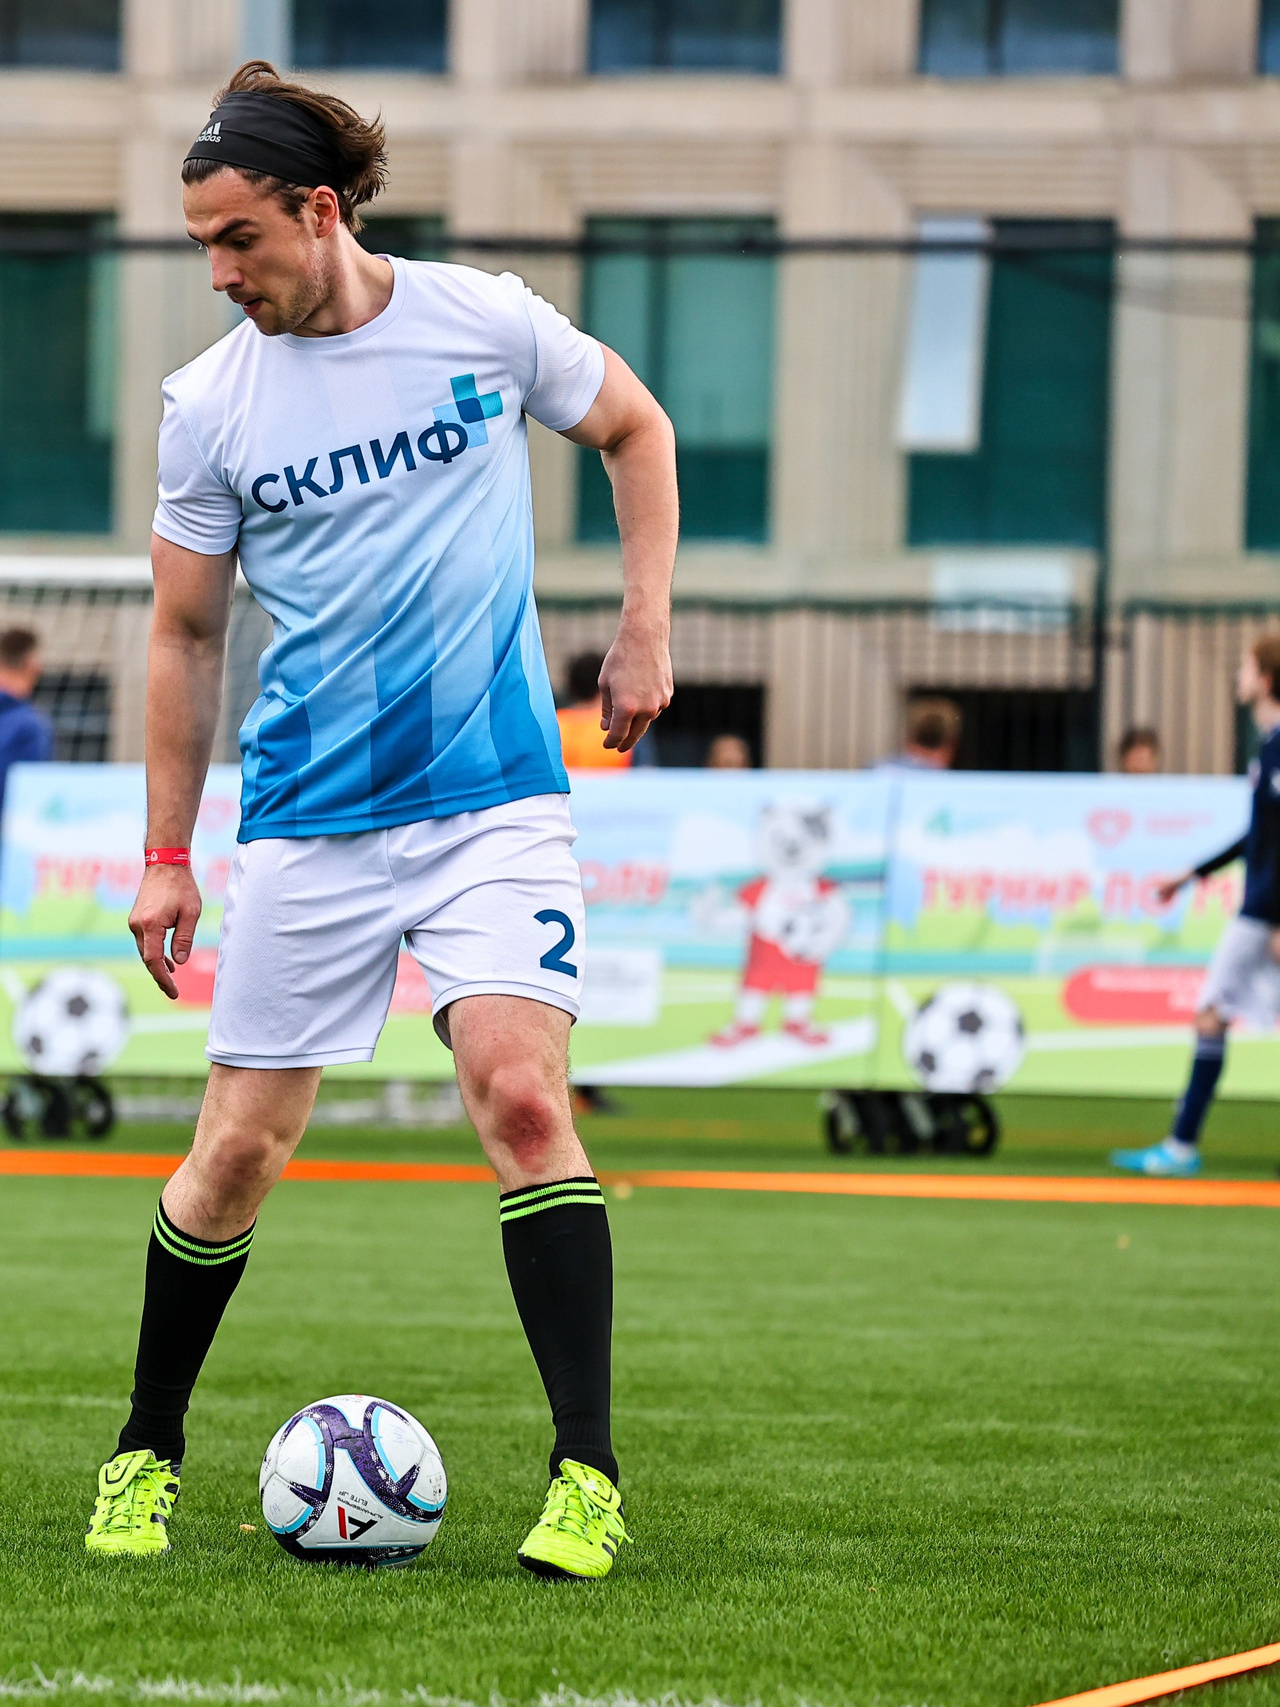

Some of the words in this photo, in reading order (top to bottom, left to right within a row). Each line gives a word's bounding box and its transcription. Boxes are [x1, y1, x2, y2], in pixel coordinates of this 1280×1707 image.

[251, 420, 469, 513] СКЛИФ
[533, 909, 577, 979] 2
[349, 1494, 368, 1506] ELITE
